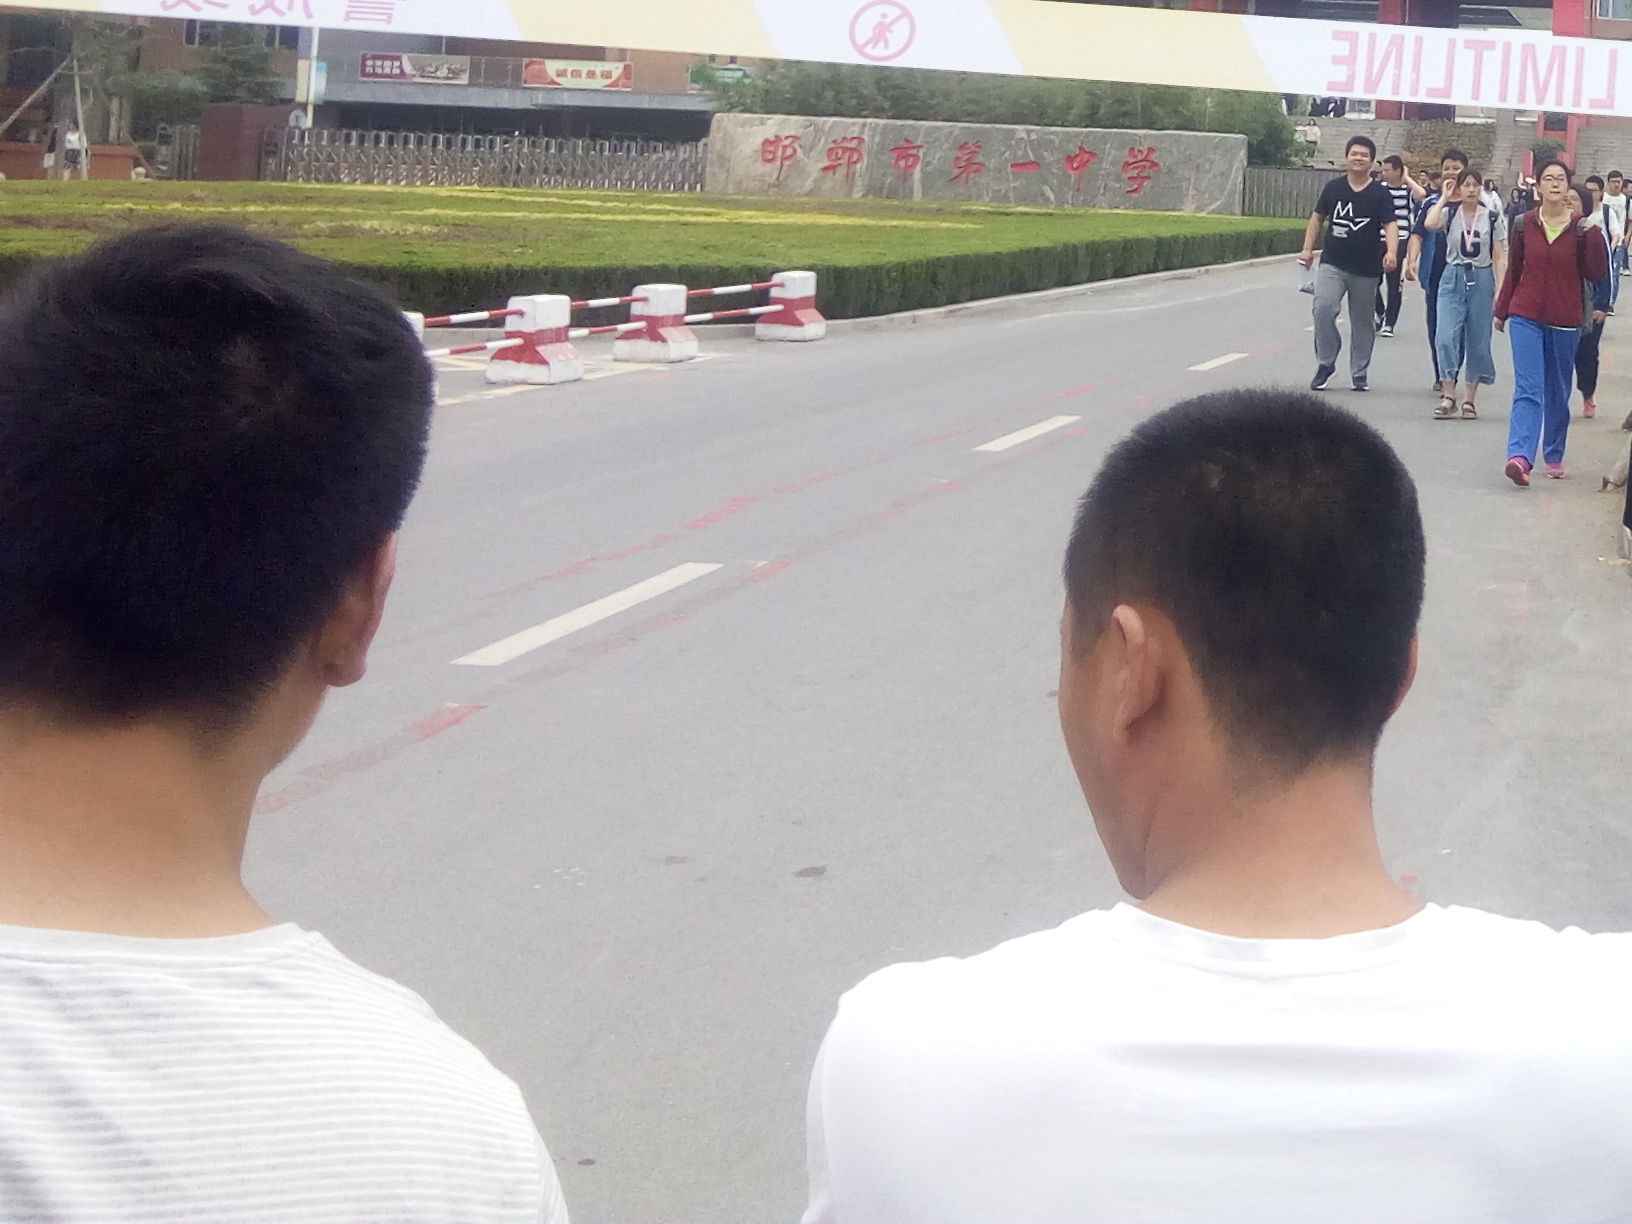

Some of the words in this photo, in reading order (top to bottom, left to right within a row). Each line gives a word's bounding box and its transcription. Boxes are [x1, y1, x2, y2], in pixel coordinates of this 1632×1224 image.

[760, 133, 1161, 195] 邯郸市第一中学
